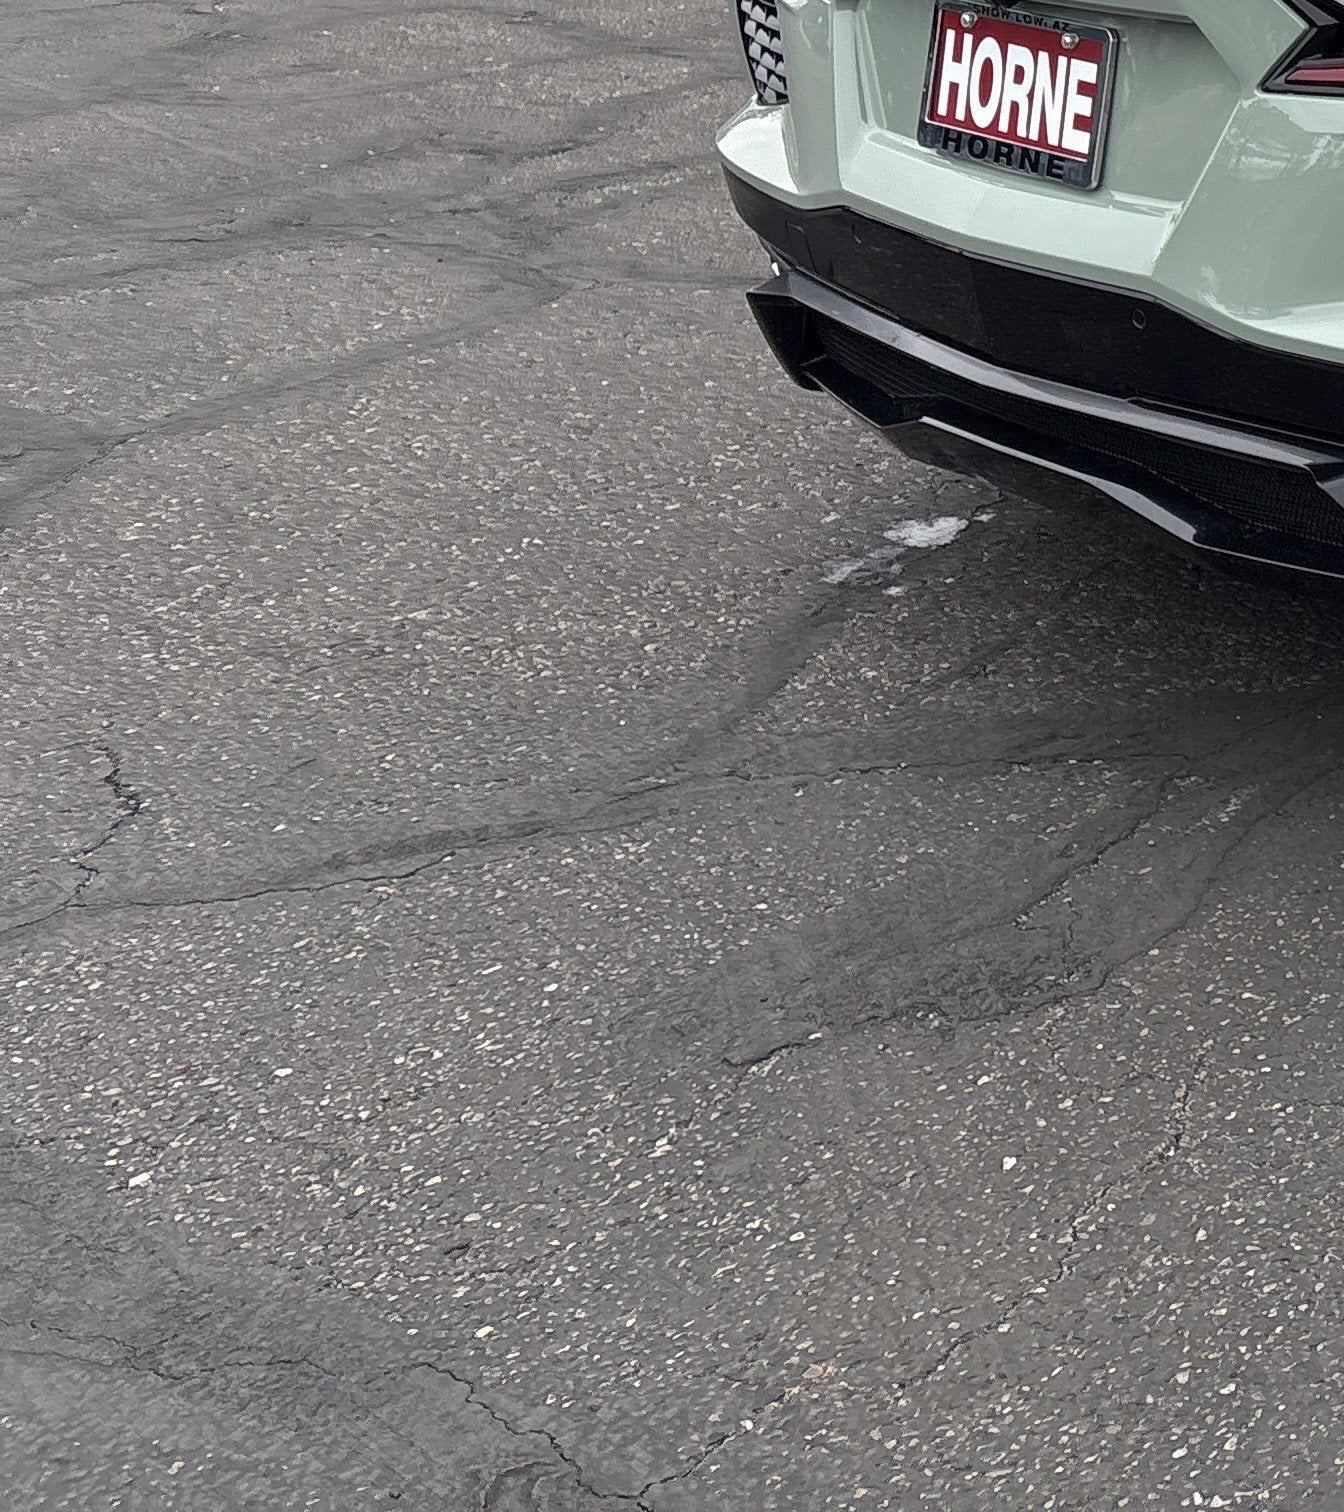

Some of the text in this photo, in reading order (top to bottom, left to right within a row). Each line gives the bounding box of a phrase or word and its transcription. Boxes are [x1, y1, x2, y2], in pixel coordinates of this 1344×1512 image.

[972, 4, 1012, 20] SHOW
[1052, 20, 1071, 32] AZ
[937, 28, 1099, 155] HORNE
[940, 128, 1066, 180] HORNE
